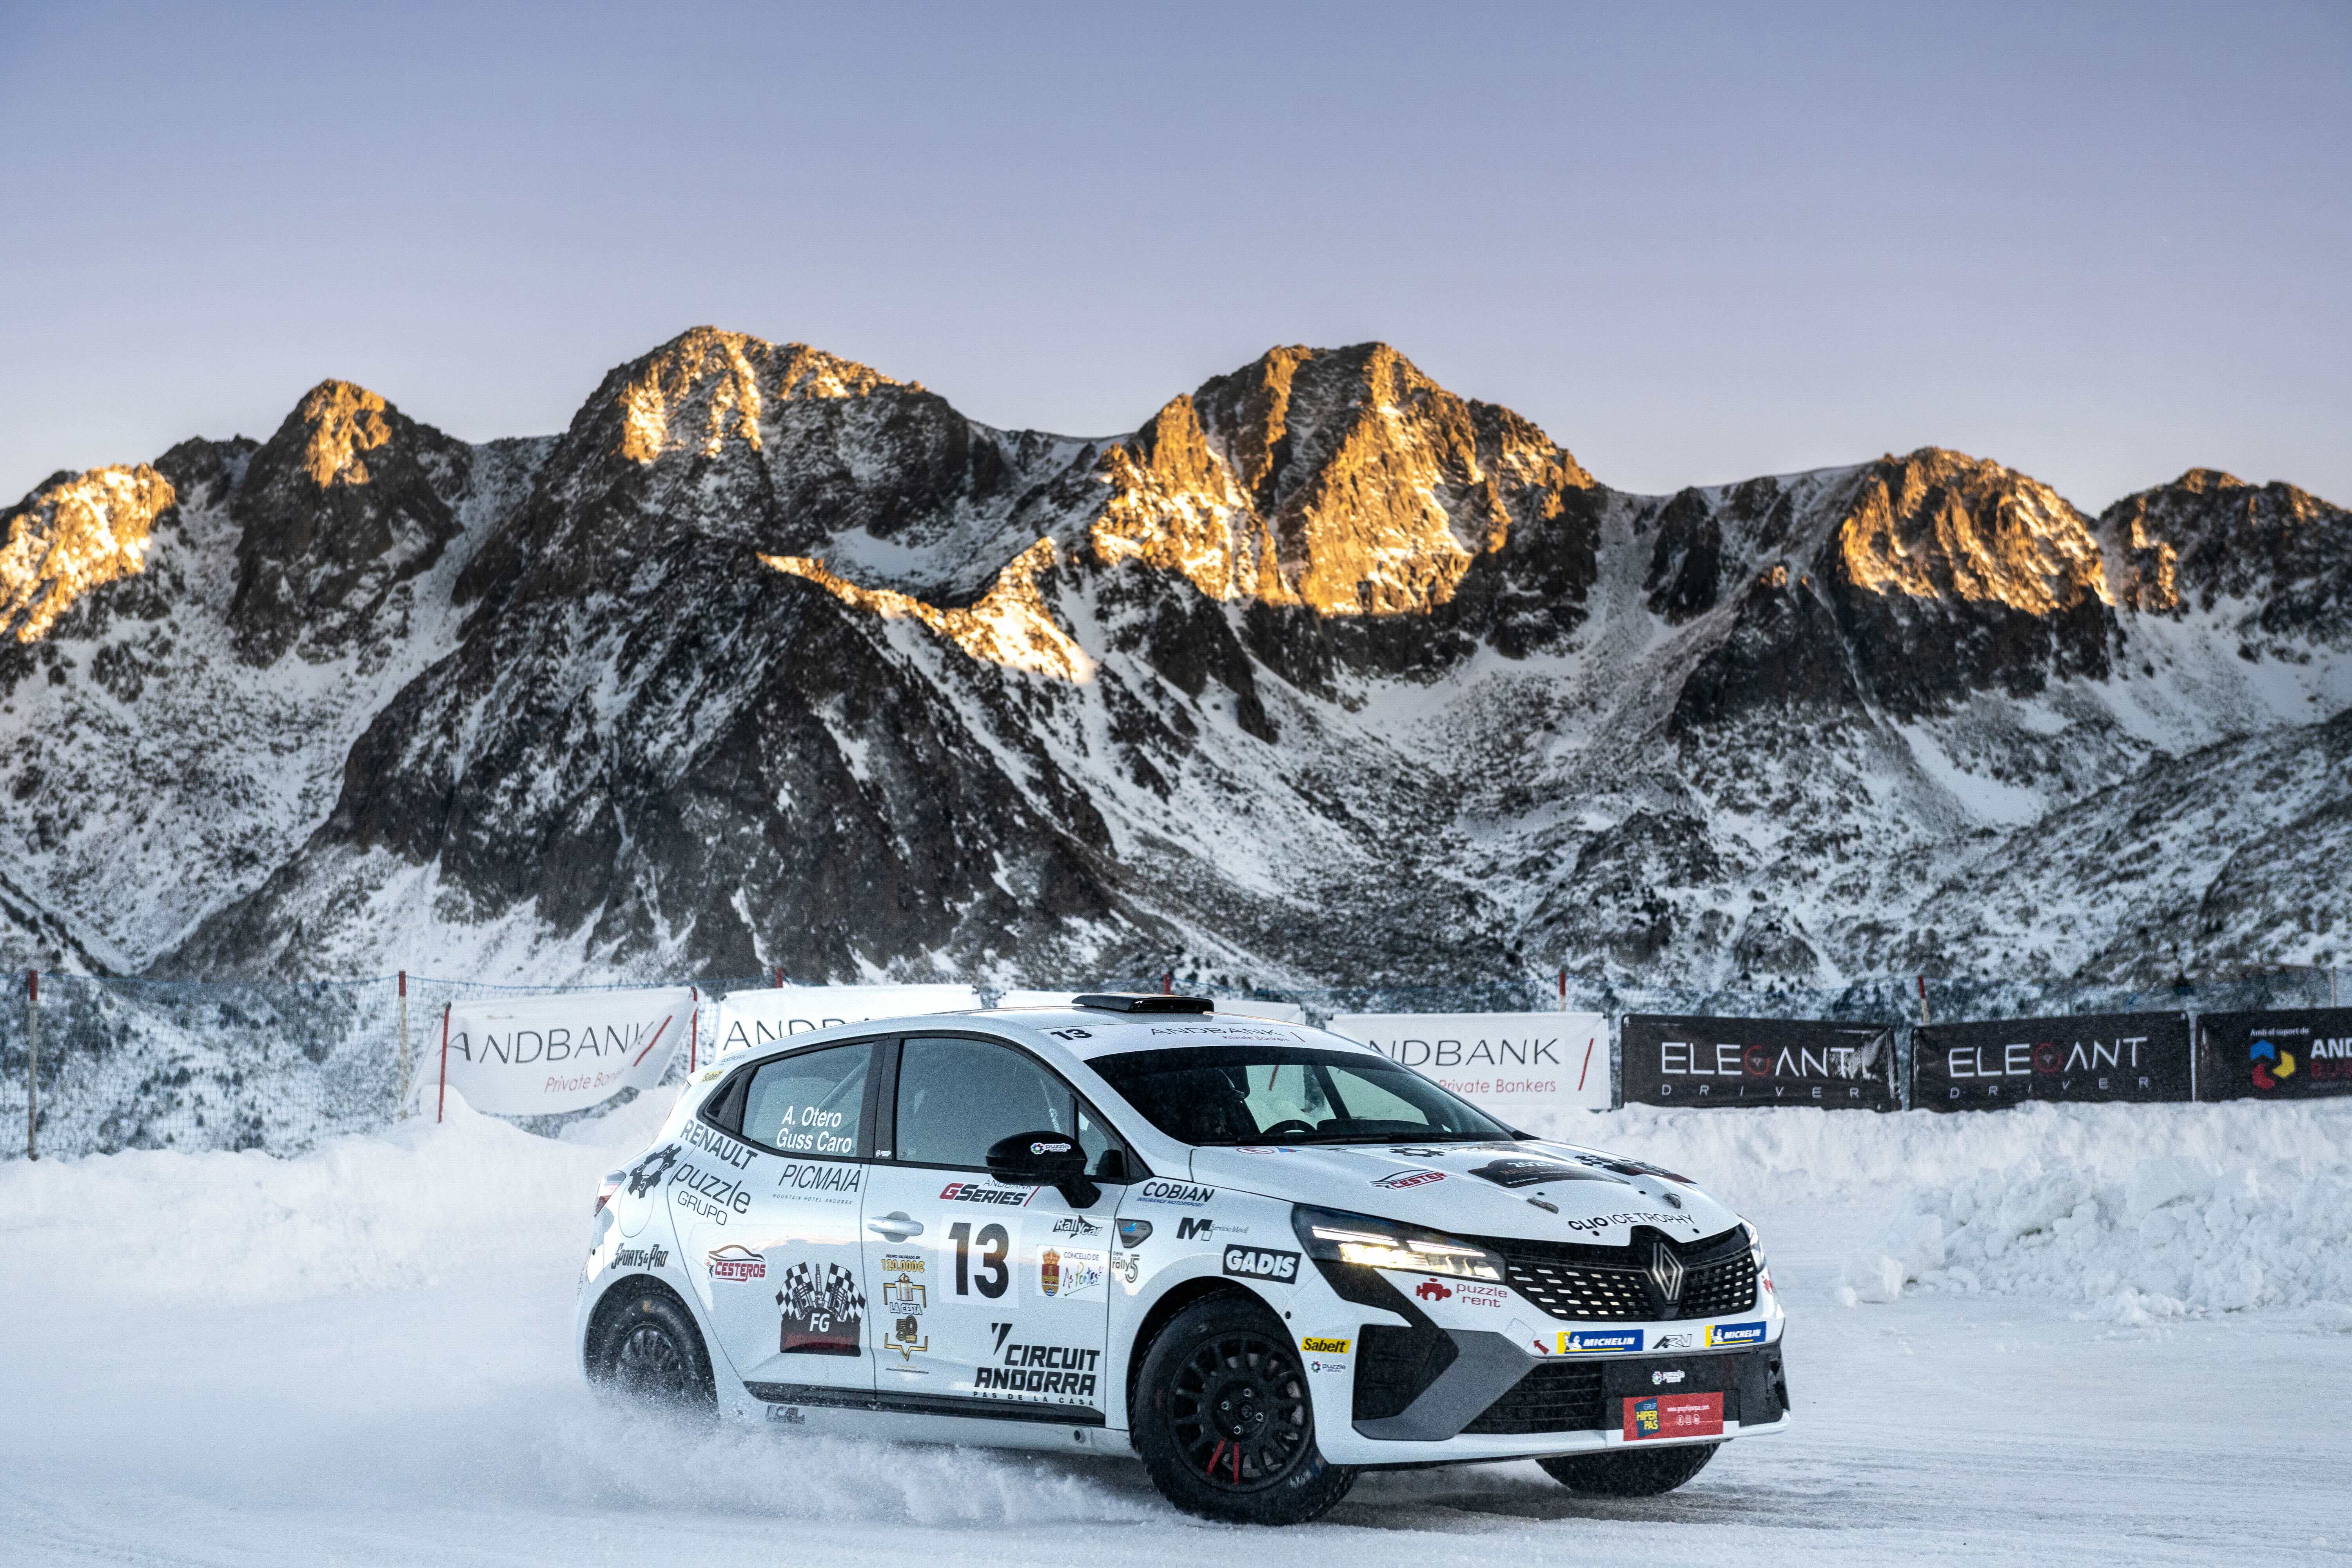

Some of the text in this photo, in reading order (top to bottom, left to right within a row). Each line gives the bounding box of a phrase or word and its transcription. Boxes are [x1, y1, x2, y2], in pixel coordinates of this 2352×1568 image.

[1051, 1029, 1093, 1040] 13
[1151, 1027, 1284, 1036] ANDBANK
[1369, 1038, 1560, 1066] NDBANK
[1661, 1042, 1855, 1079] ELEGANT
[1948, 1036, 2148, 1078] ELEGANT
[544, 1073, 590, 1093] Private
[1439, 1078, 1556, 1093] Private Bankers
[1661, 1084, 1860, 1098] DRIVER
[1950, 1076, 2149, 1098] DRIVER
[781, 1105, 842, 1128] A. Otero
[680, 1119, 758, 1170] RENAULT
[776, 1128, 852, 1153] Guss Caro
[668, 1163, 751, 1214] puzzle
[1143, 1181, 1215, 1202] COBIAN
[677, 1190, 727, 1225] GRUPO
[1056, 1218, 1104, 1236] Rallycar
[1568, 1217, 1608, 1230] CLIO
[881, 1258, 925, 1273] 120.000€
[948, 1221, 1009, 1299] 13
[1064, 1252, 1092, 1260] CONCELLO
[1226, 1249, 1296, 1278] GADIS
[714, 1261, 766, 1281] CESTEROS
[1456, 1282, 1508, 1298] puzzle
[889, 1302, 923, 1315] LA CESTA
[1462, 1294, 1501, 1308] rent
[809, 1313, 830, 1332] FG
[1583, 1336, 1635, 1347] MICHELIN
[1724, 1328, 1762, 1339] MICHELIN
[1303, 1338, 1346, 1353] Sabelt
[1004, 1344, 1101, 1372] CIRCUIT
[974, 1367, 1096, 1396] ANDORRA
[1059, 1397, 1094, 1406] CASA
[1636, 1410, 1658, 1421] HIPER
